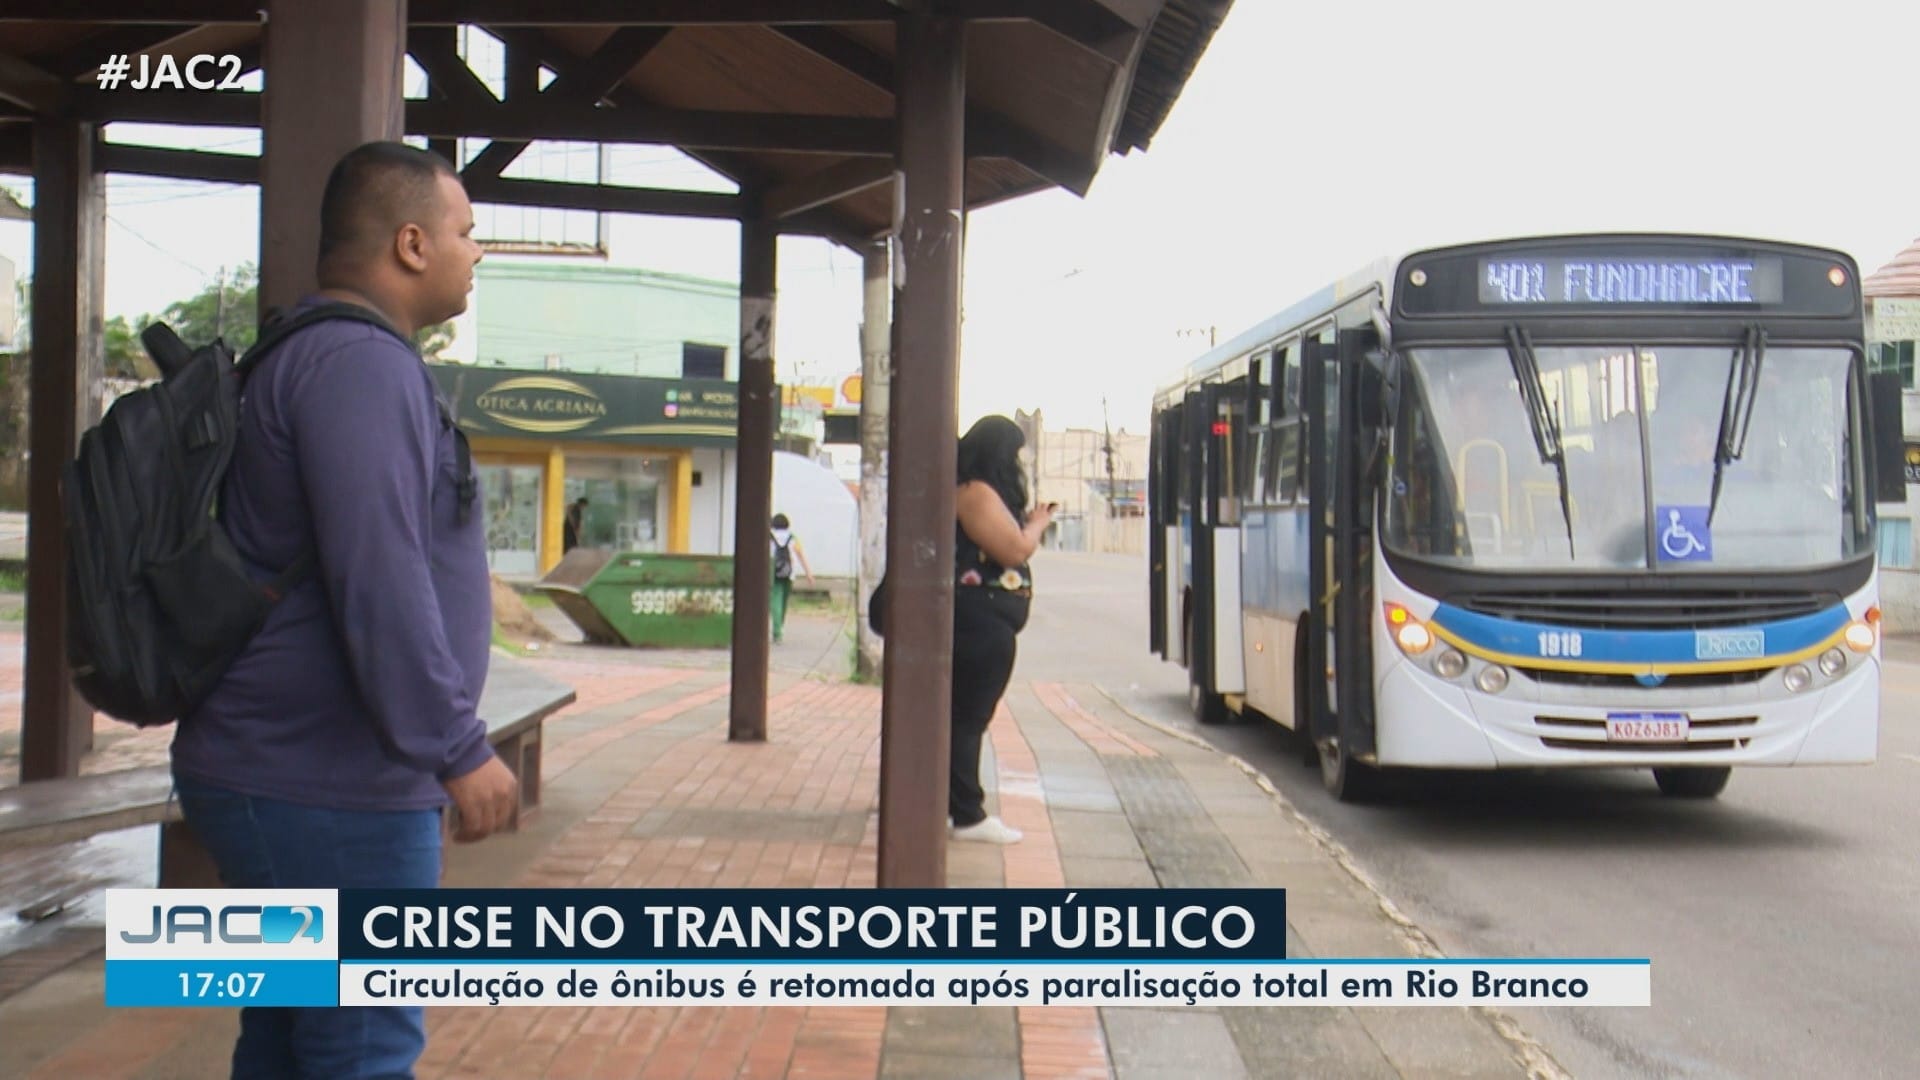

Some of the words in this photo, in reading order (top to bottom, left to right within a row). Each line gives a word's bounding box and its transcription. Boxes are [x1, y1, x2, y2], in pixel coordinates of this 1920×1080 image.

[1487, 263, 1546, 302] 401
[1564, 263, 1753, 302] FUNDHACRE
[533, 399, 607, 416] ACRIANA
